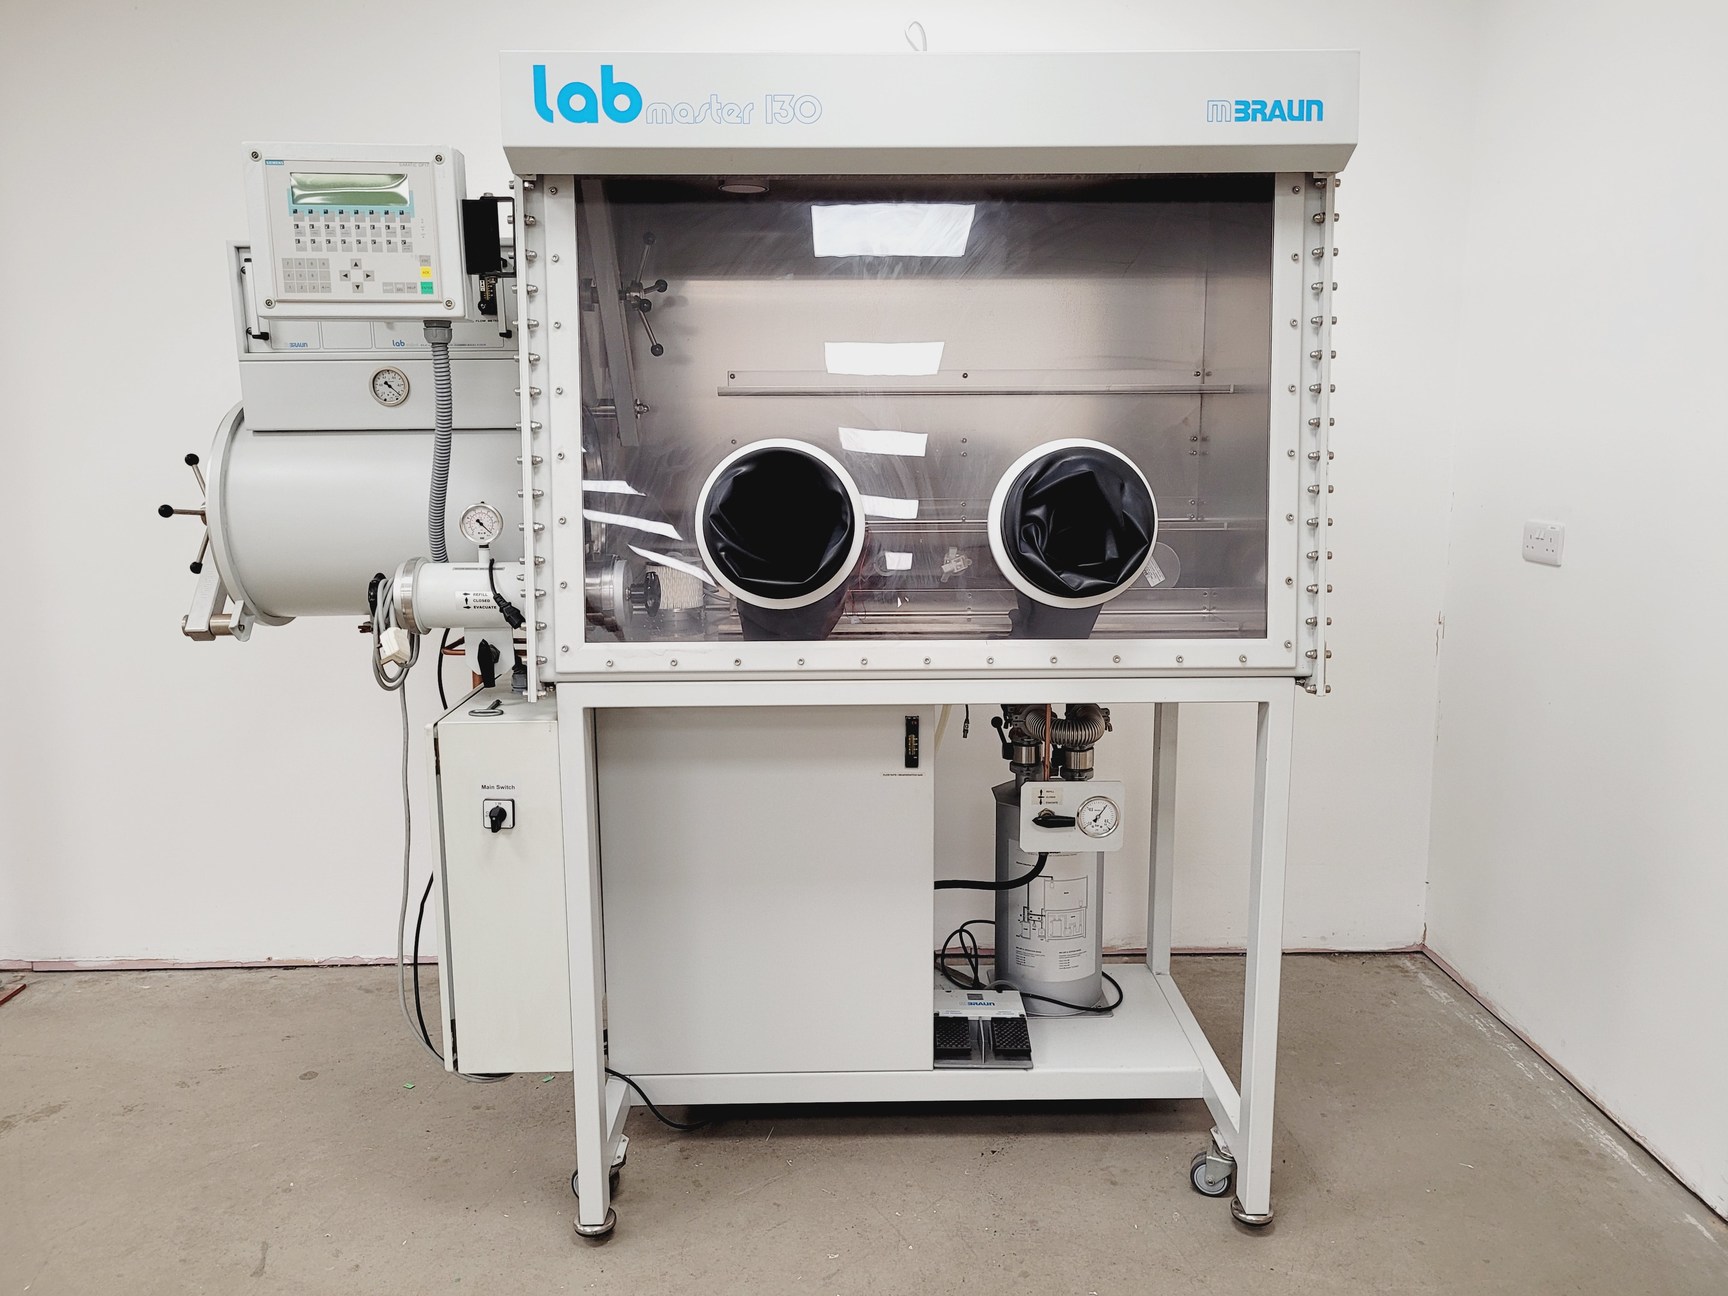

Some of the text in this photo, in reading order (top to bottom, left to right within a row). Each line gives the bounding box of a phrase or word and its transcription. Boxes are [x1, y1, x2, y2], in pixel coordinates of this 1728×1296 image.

[533, 64, 823, 125] lab master 130
